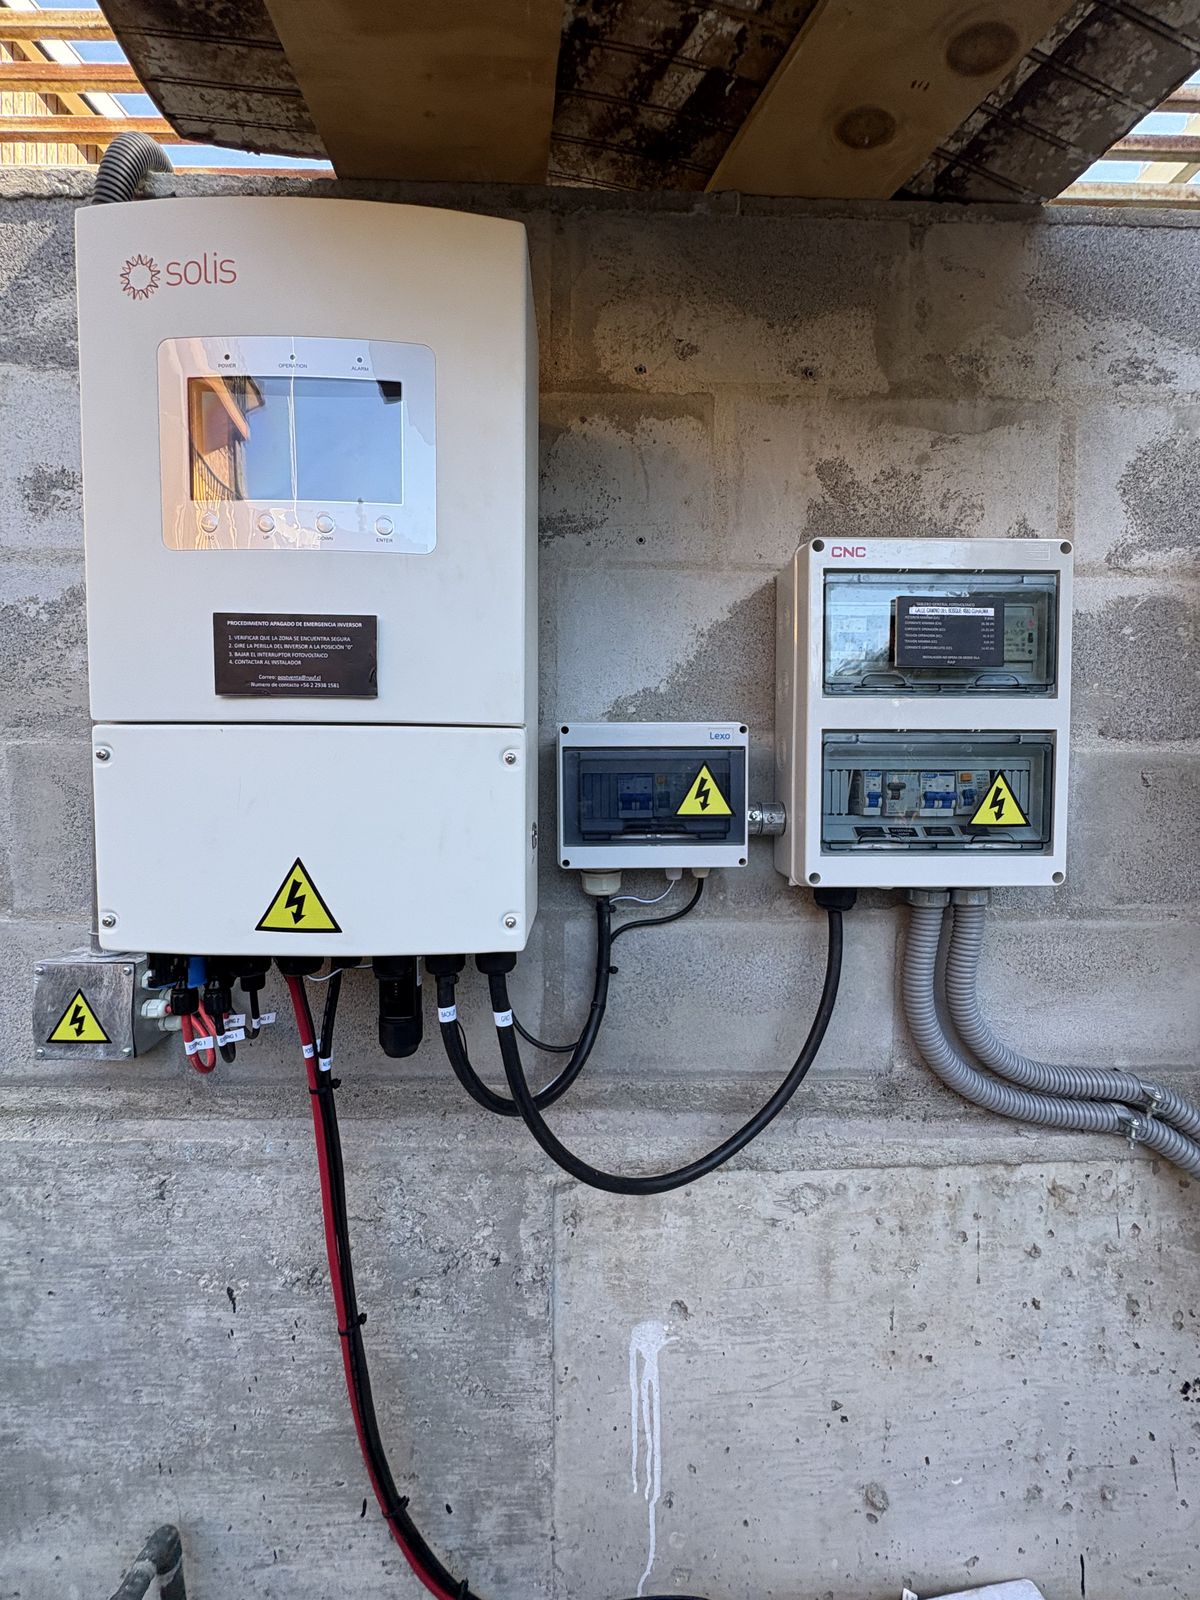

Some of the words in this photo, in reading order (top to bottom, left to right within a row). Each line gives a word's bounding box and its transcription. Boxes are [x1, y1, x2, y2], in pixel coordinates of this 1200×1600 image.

[166, 252, 237, 286] solis
[831, 546, 866, 558] CNC
[710, 731, 730, 740] Lexo
